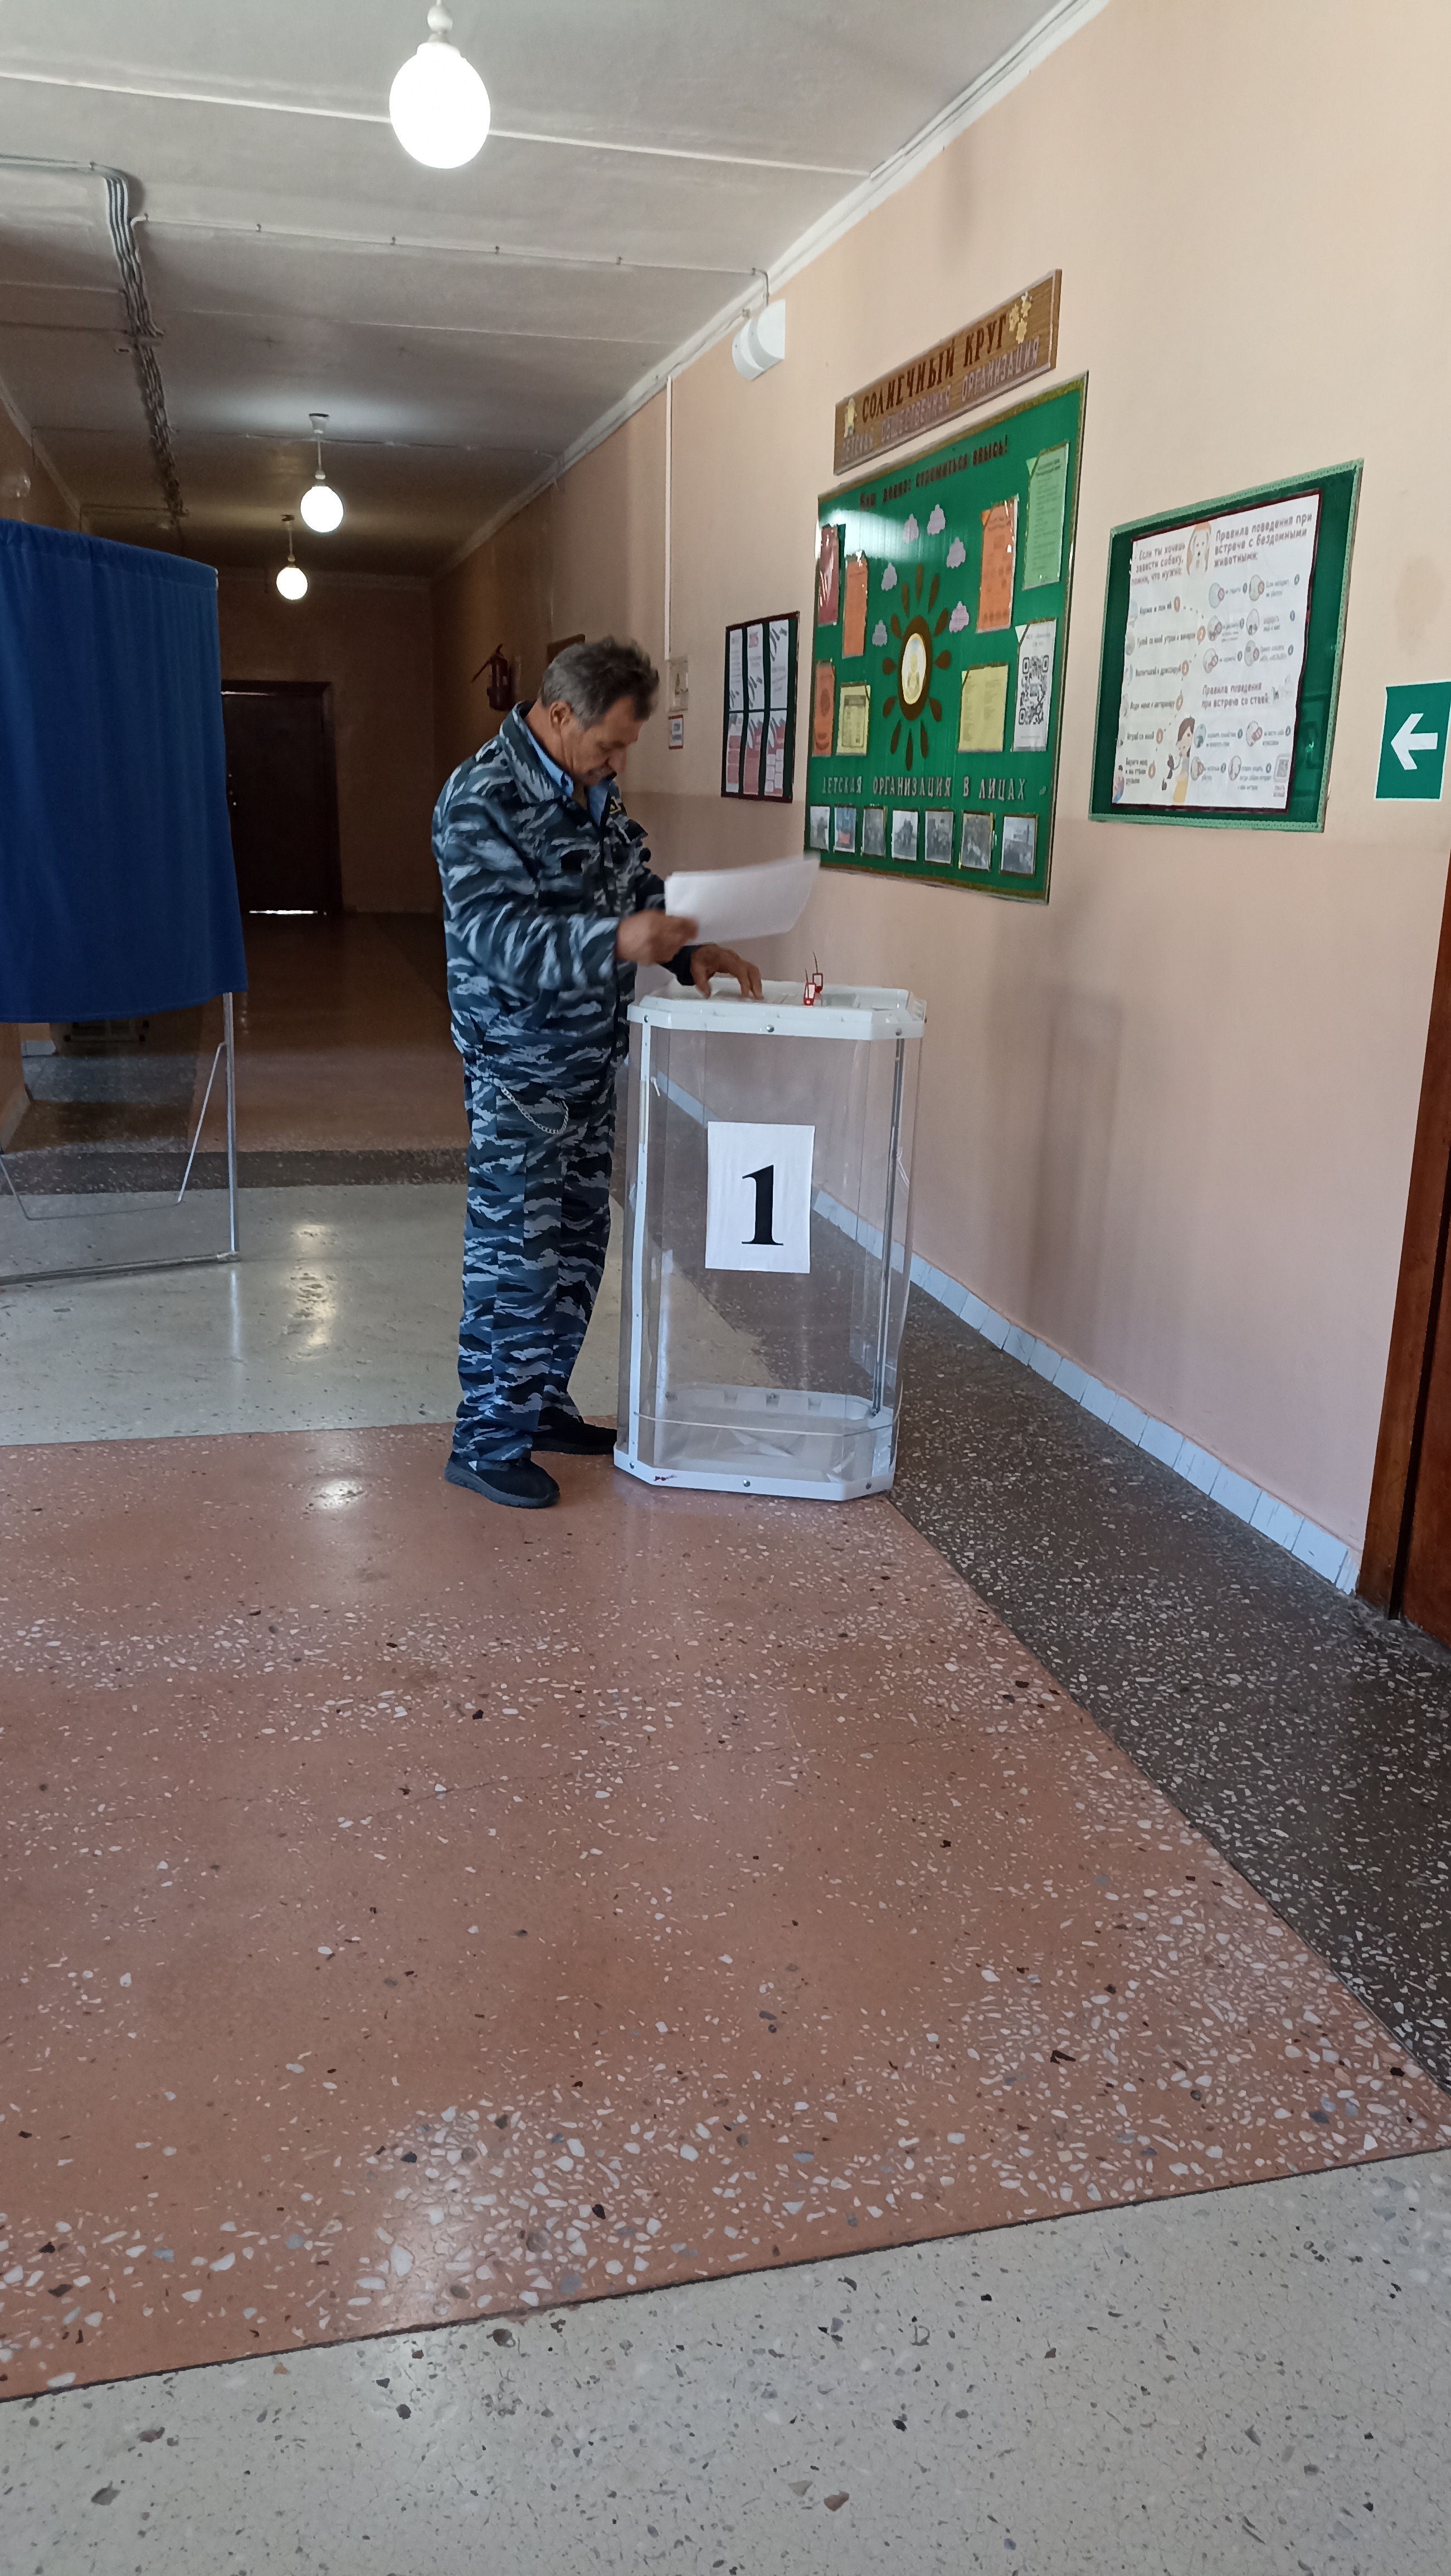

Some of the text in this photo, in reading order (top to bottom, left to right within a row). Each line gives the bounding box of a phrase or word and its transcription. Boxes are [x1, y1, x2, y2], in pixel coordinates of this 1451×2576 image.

[862, 314, 1007, 423] СОЛНЕЧНЫЙ КРУГ
[962, 335, 1039, 402] ОРГАНИЗАЦИЯ
[1216, 513, 1312, 541] Правила поведения при
[1154, 546, 1163, 556] ты
[1215, 528, 1307, 555] встрече с бездомными
[1202, 685, 1228, 696] Правила
[1213, 698, 1239, 709] встрече
[1241, 697, 1248, 706] со
[822, 775, 1026, 801] ДЕТСКАЯ ОРГАНИЗАЦИЯ В ЛИЦАХ
[741, 1163, 785, 1247] 1
